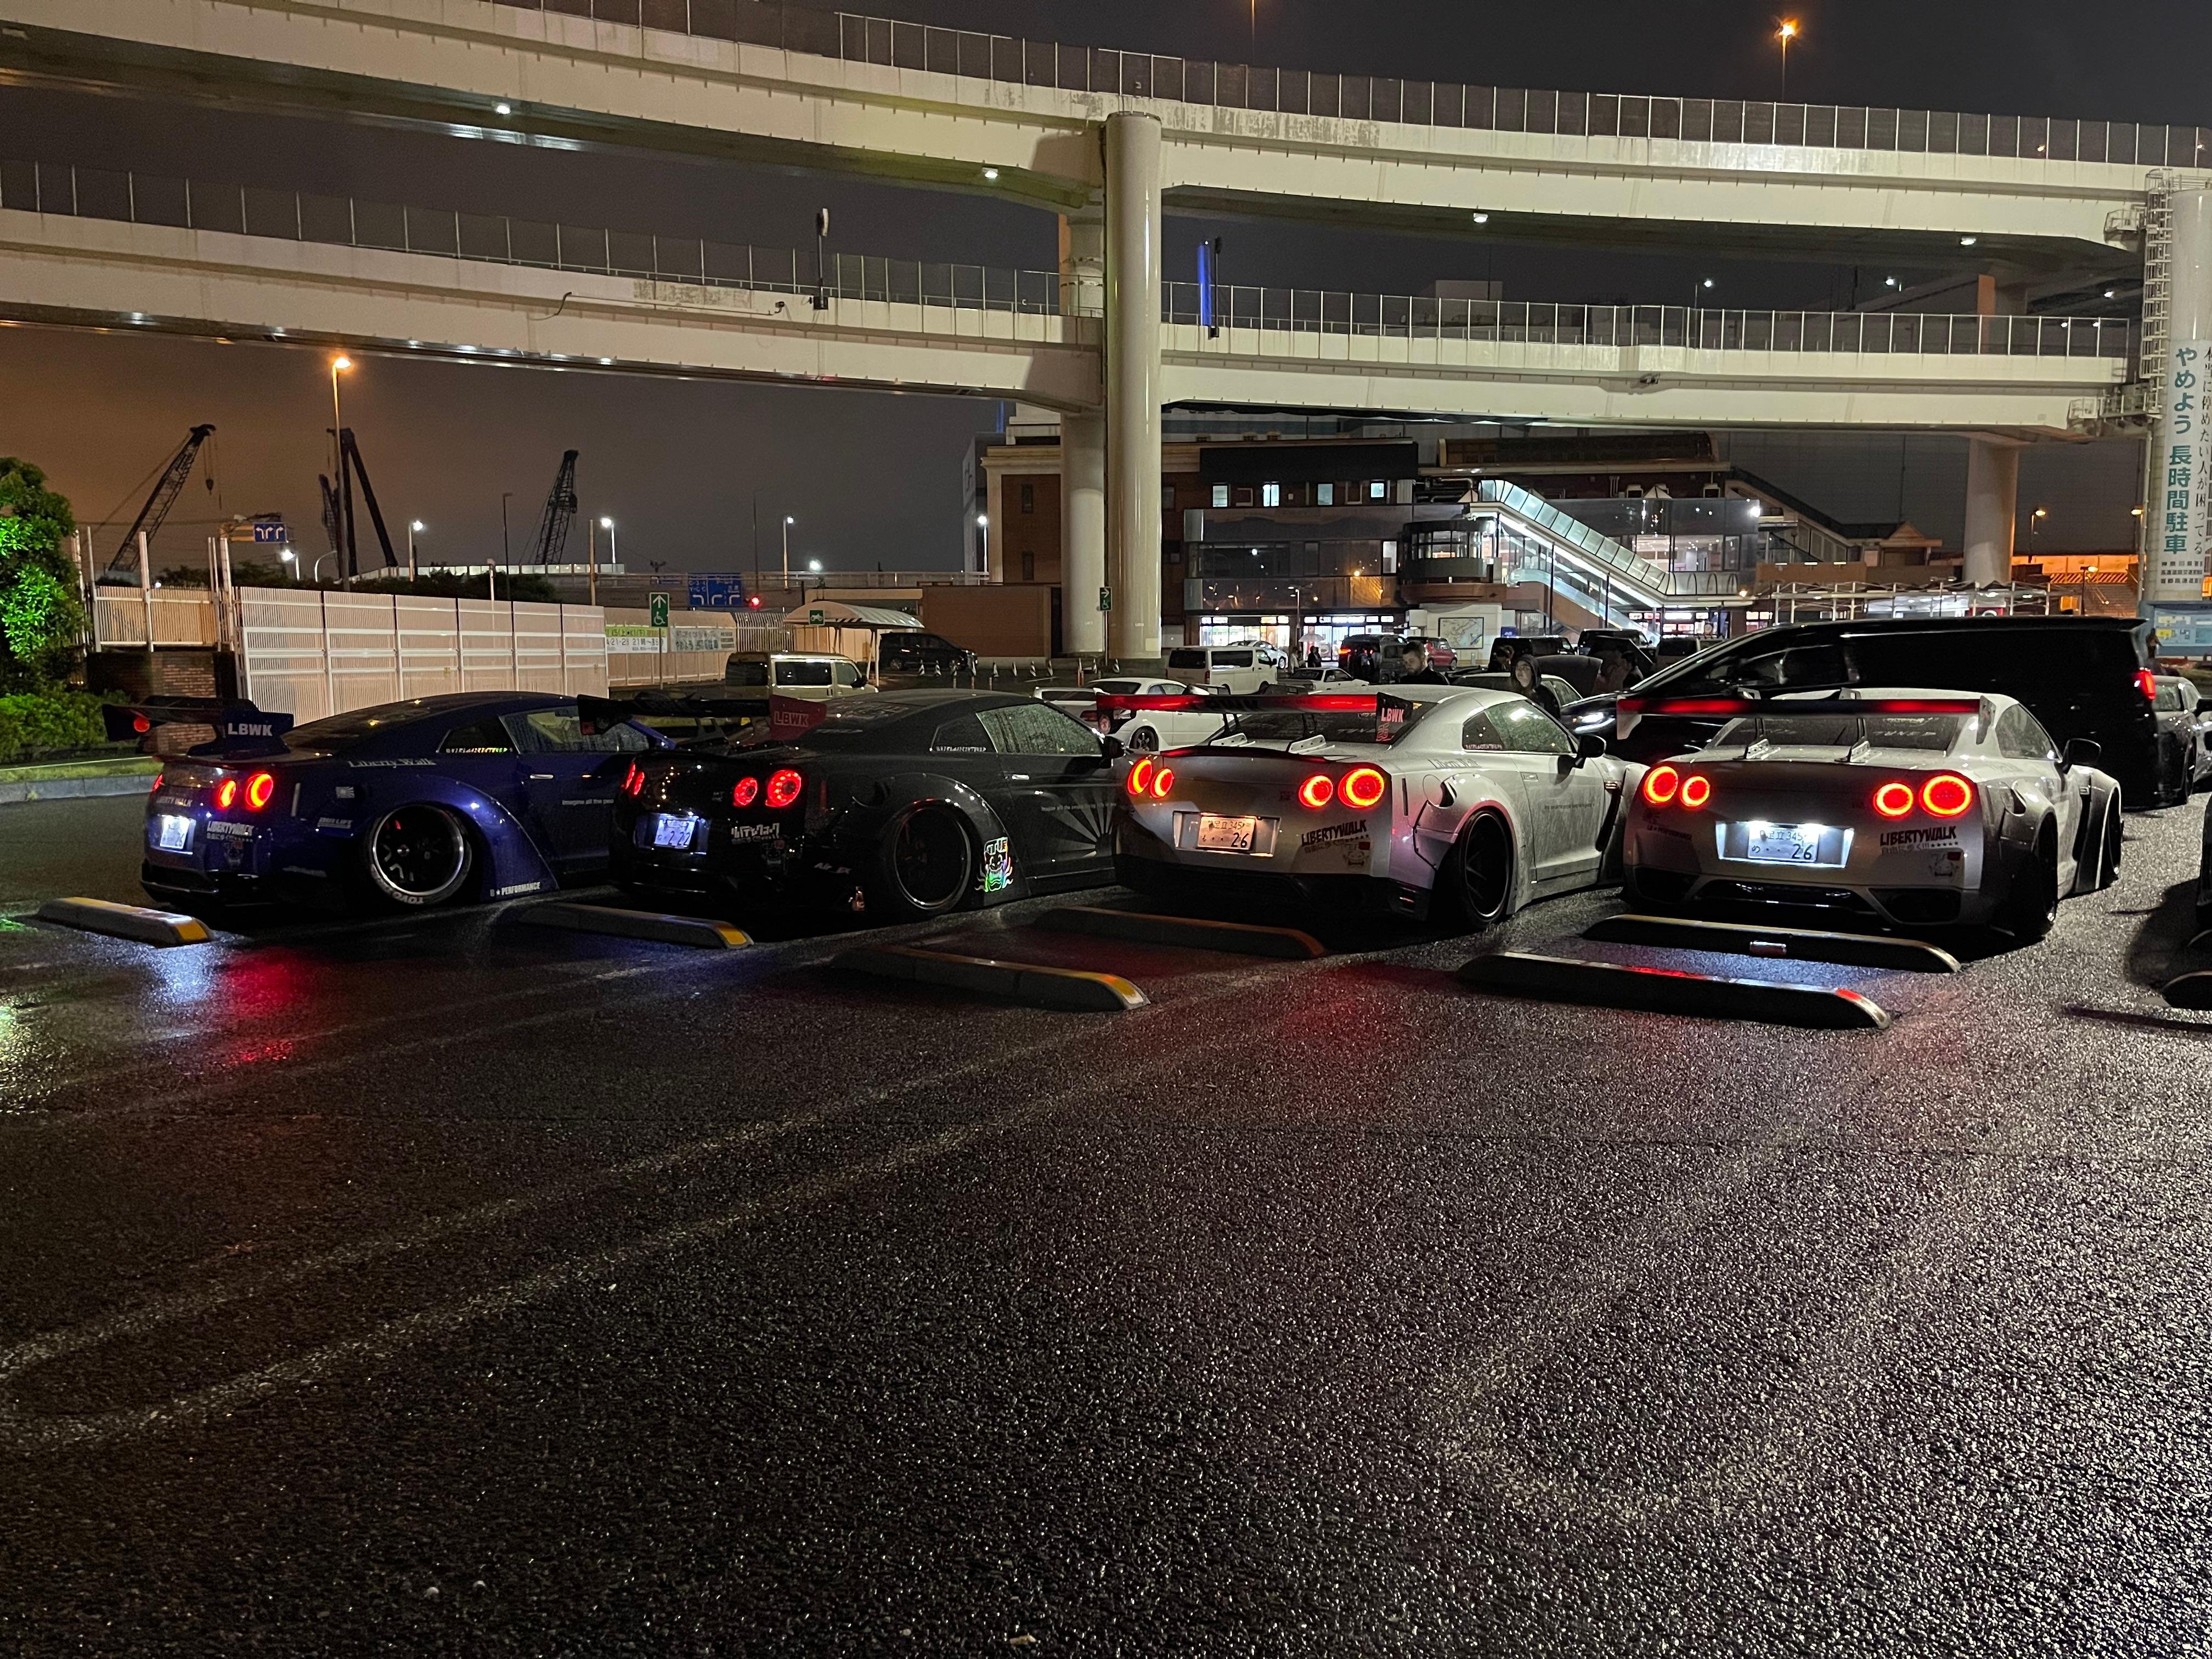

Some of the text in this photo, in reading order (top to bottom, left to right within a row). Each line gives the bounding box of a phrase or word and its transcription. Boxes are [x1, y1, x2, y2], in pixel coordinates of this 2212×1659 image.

[2174, 347, 2198, 435] やめよう
[2164, 444, 2192, 555] 長時間駐車
[774, 711, 809, 727] LBWK
[1381, 707, 1404, 723] LBWK
[228, 723, 273, 737] LBWK
[1231, 832, 1250, 848] 26
[1301, 820, 1367, 847] LIBERTYWALK
[1786, 831, 1803, 841] 345
[1880, 826, 1957, 846] LIBERTYWALK
[1791, 843, 1814, 860] 26
[501, 882, 540, 896] PERFORMANCE
